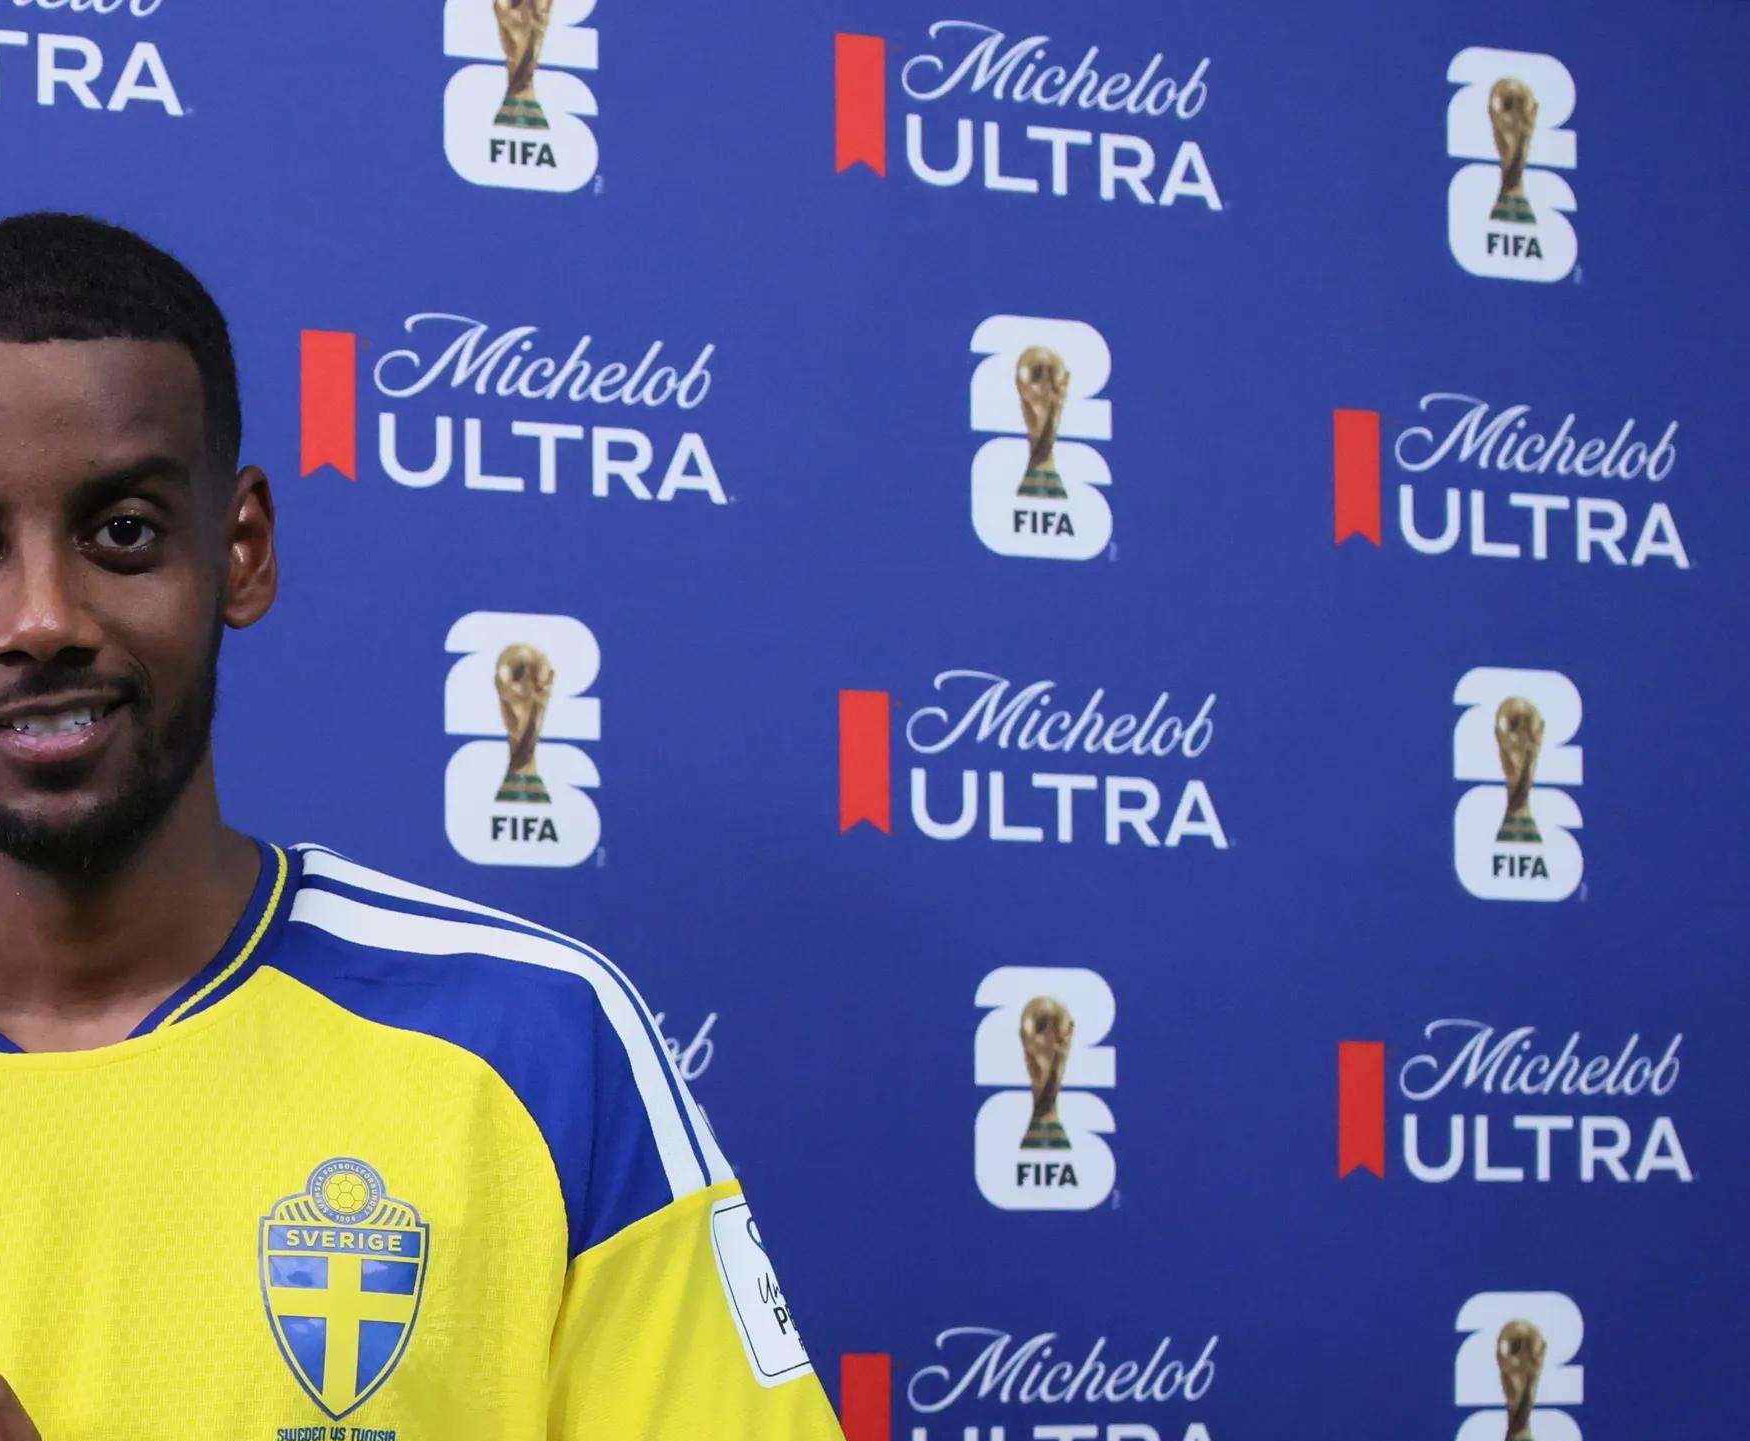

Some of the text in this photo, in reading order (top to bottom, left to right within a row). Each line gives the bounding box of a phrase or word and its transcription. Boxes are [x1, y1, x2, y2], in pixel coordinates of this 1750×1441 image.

[900, 19, 1211, 121] Michelob
[489, 138, 558, 169] FIFA
[905, 112, 1224, 212] ULTRA
[1486, 232, 1543, 259] FIFA
[373, 312, 716, 409] Michelob
[378, 411, 729, 506] ULTRA
[1394, 392, 1679, 482] Michelob
[1013, 509, 1075, 537] FIFA
[1398, 483, 1691, 570] ULTRA
[905, 669, 1217, 759] Michelob
[491, 816, 559, 843] FIFA
[910, 767, 1230, 850] ULTRA
[1492, 854, 1549, 879] FIFA
[1398, 1018, 1683, 1101] Michelob
[1016, 1162, 1079, 1187] FIFA
[1402, 1112, 1694, 1184] ULTRA
[286, 1229, 403, 1252] SVERIGE
[907, 1326, 1219, 1413] Michelob
